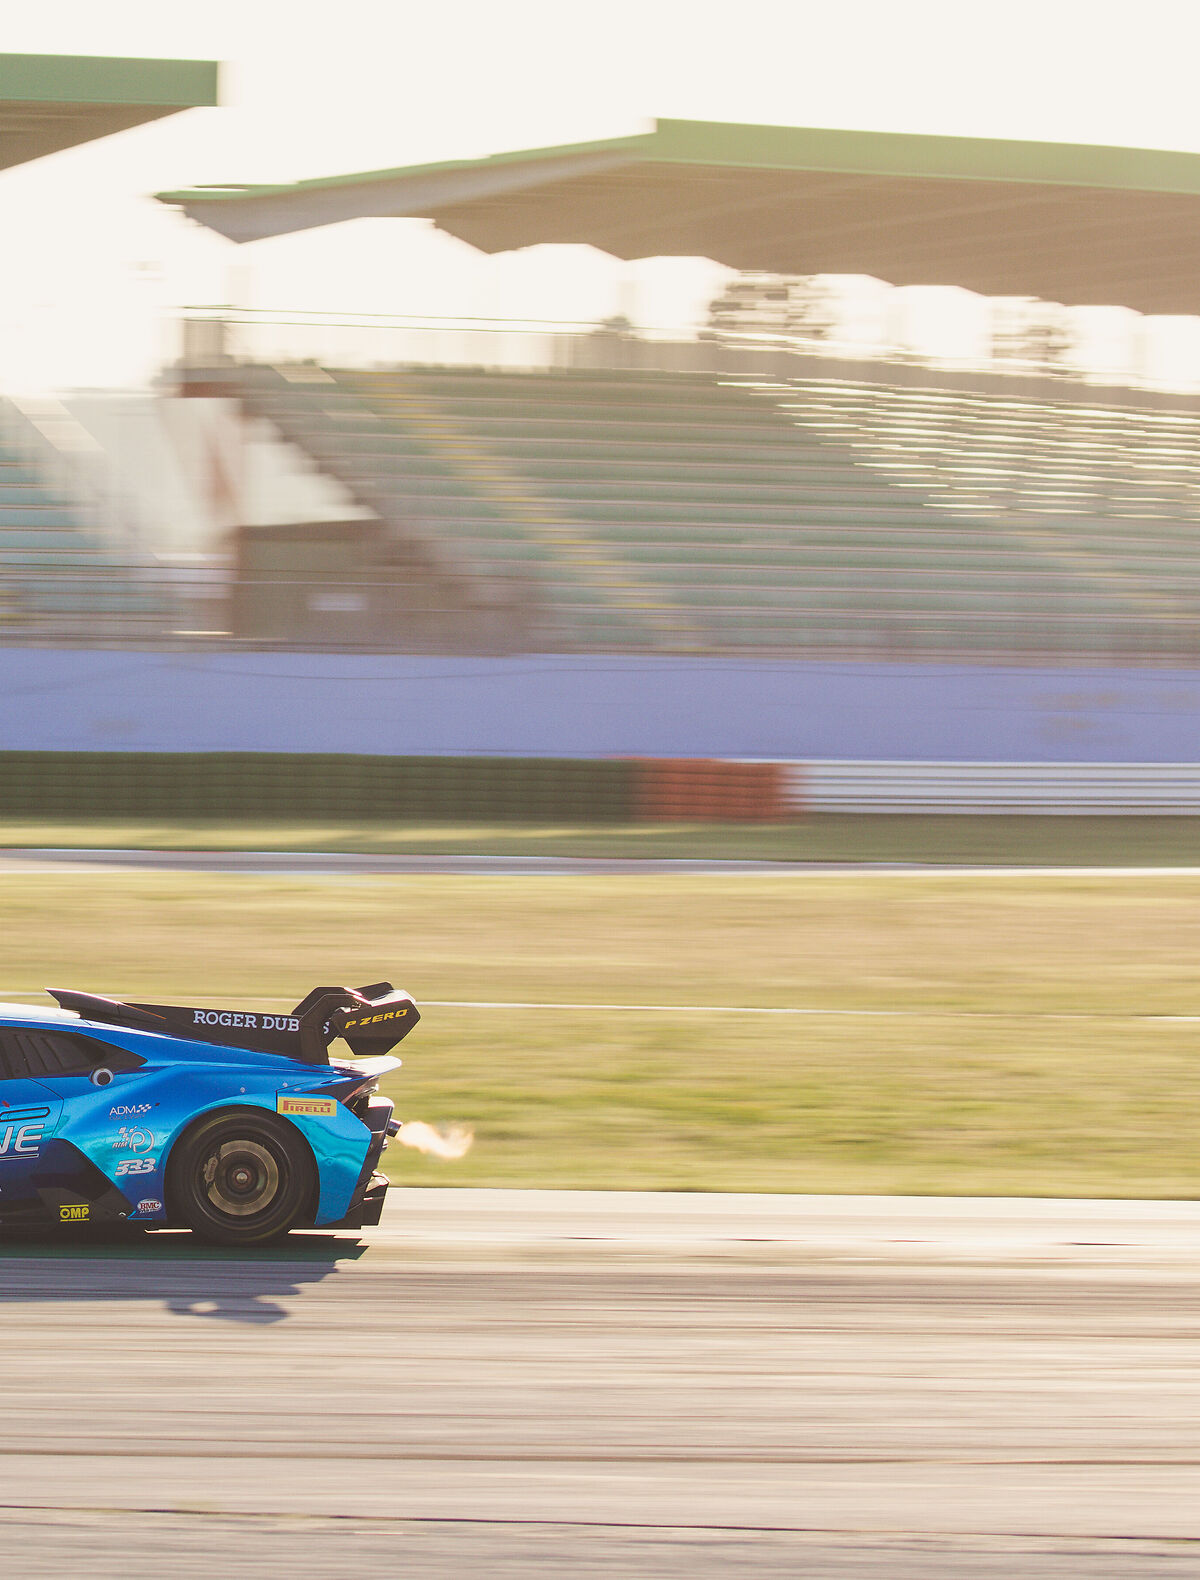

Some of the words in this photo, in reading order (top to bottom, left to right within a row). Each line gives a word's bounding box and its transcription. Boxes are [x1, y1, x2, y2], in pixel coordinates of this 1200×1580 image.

[193, 1010, 257, 1029] ROGER
[262, 1016, 330, 1035] DUBS
[345, 1020, 357, 1029] P
[360, 1009, 408, 1026] ZERO
[109, 1105, 136, 1116] ADM
[283, 1100, 331, 1113] PIRELLI
[114, 1158, 157, 1176] 333
[60, 1207, 90, 1219] OMP
